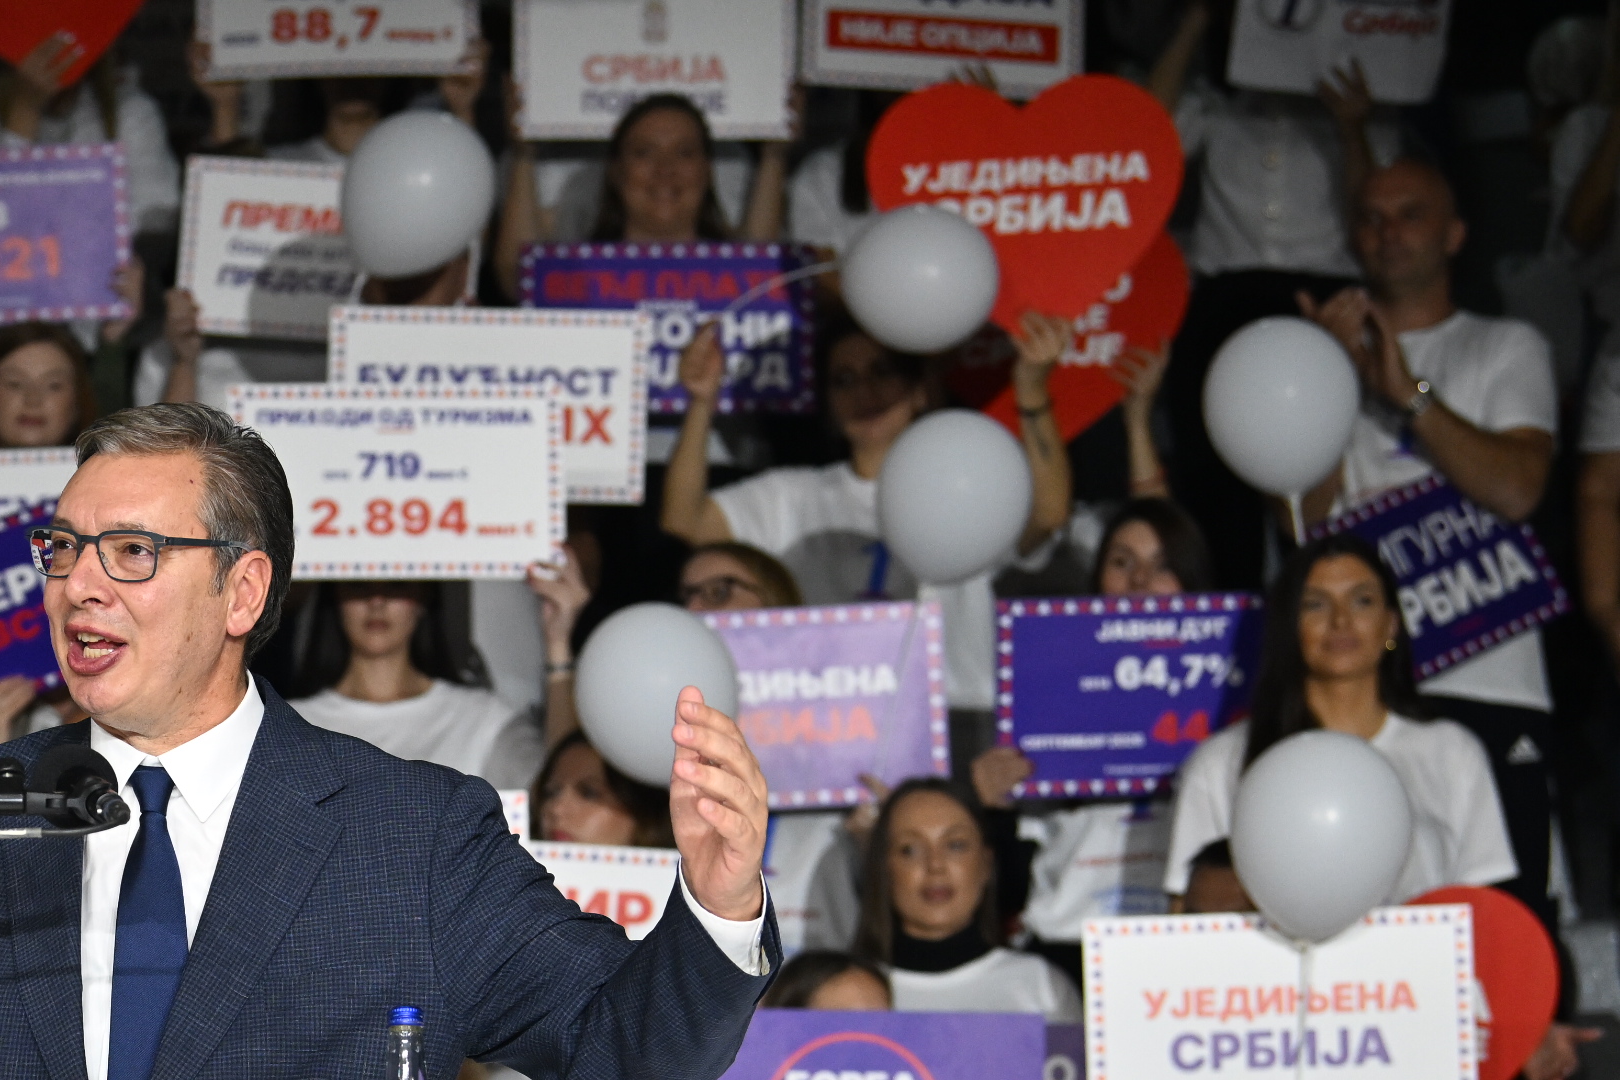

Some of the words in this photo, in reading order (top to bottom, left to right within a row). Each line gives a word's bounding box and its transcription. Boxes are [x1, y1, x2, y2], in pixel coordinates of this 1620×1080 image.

[272, 8, 380, 50] 88,7
[900, 149, 1151, 196] УЈЕДИЊЕНА
[914, 188, 1133, 236] РБИЈА
[380, 408, 415, 428] ОД
[421, 407, 533, 426] ТУРИЗМА
[357, 452, 422, 481] 719
[310, 498, 468, 537] 2.894
[1395, 536, 1540, 640] РБИЈА
[1114, 652, 1246, 697] 64,7%
[1143, 981, 1418, 1023] УЈЕДИЊЕНА
[1170, 1025, 1392, 1072] СРБИЈА
